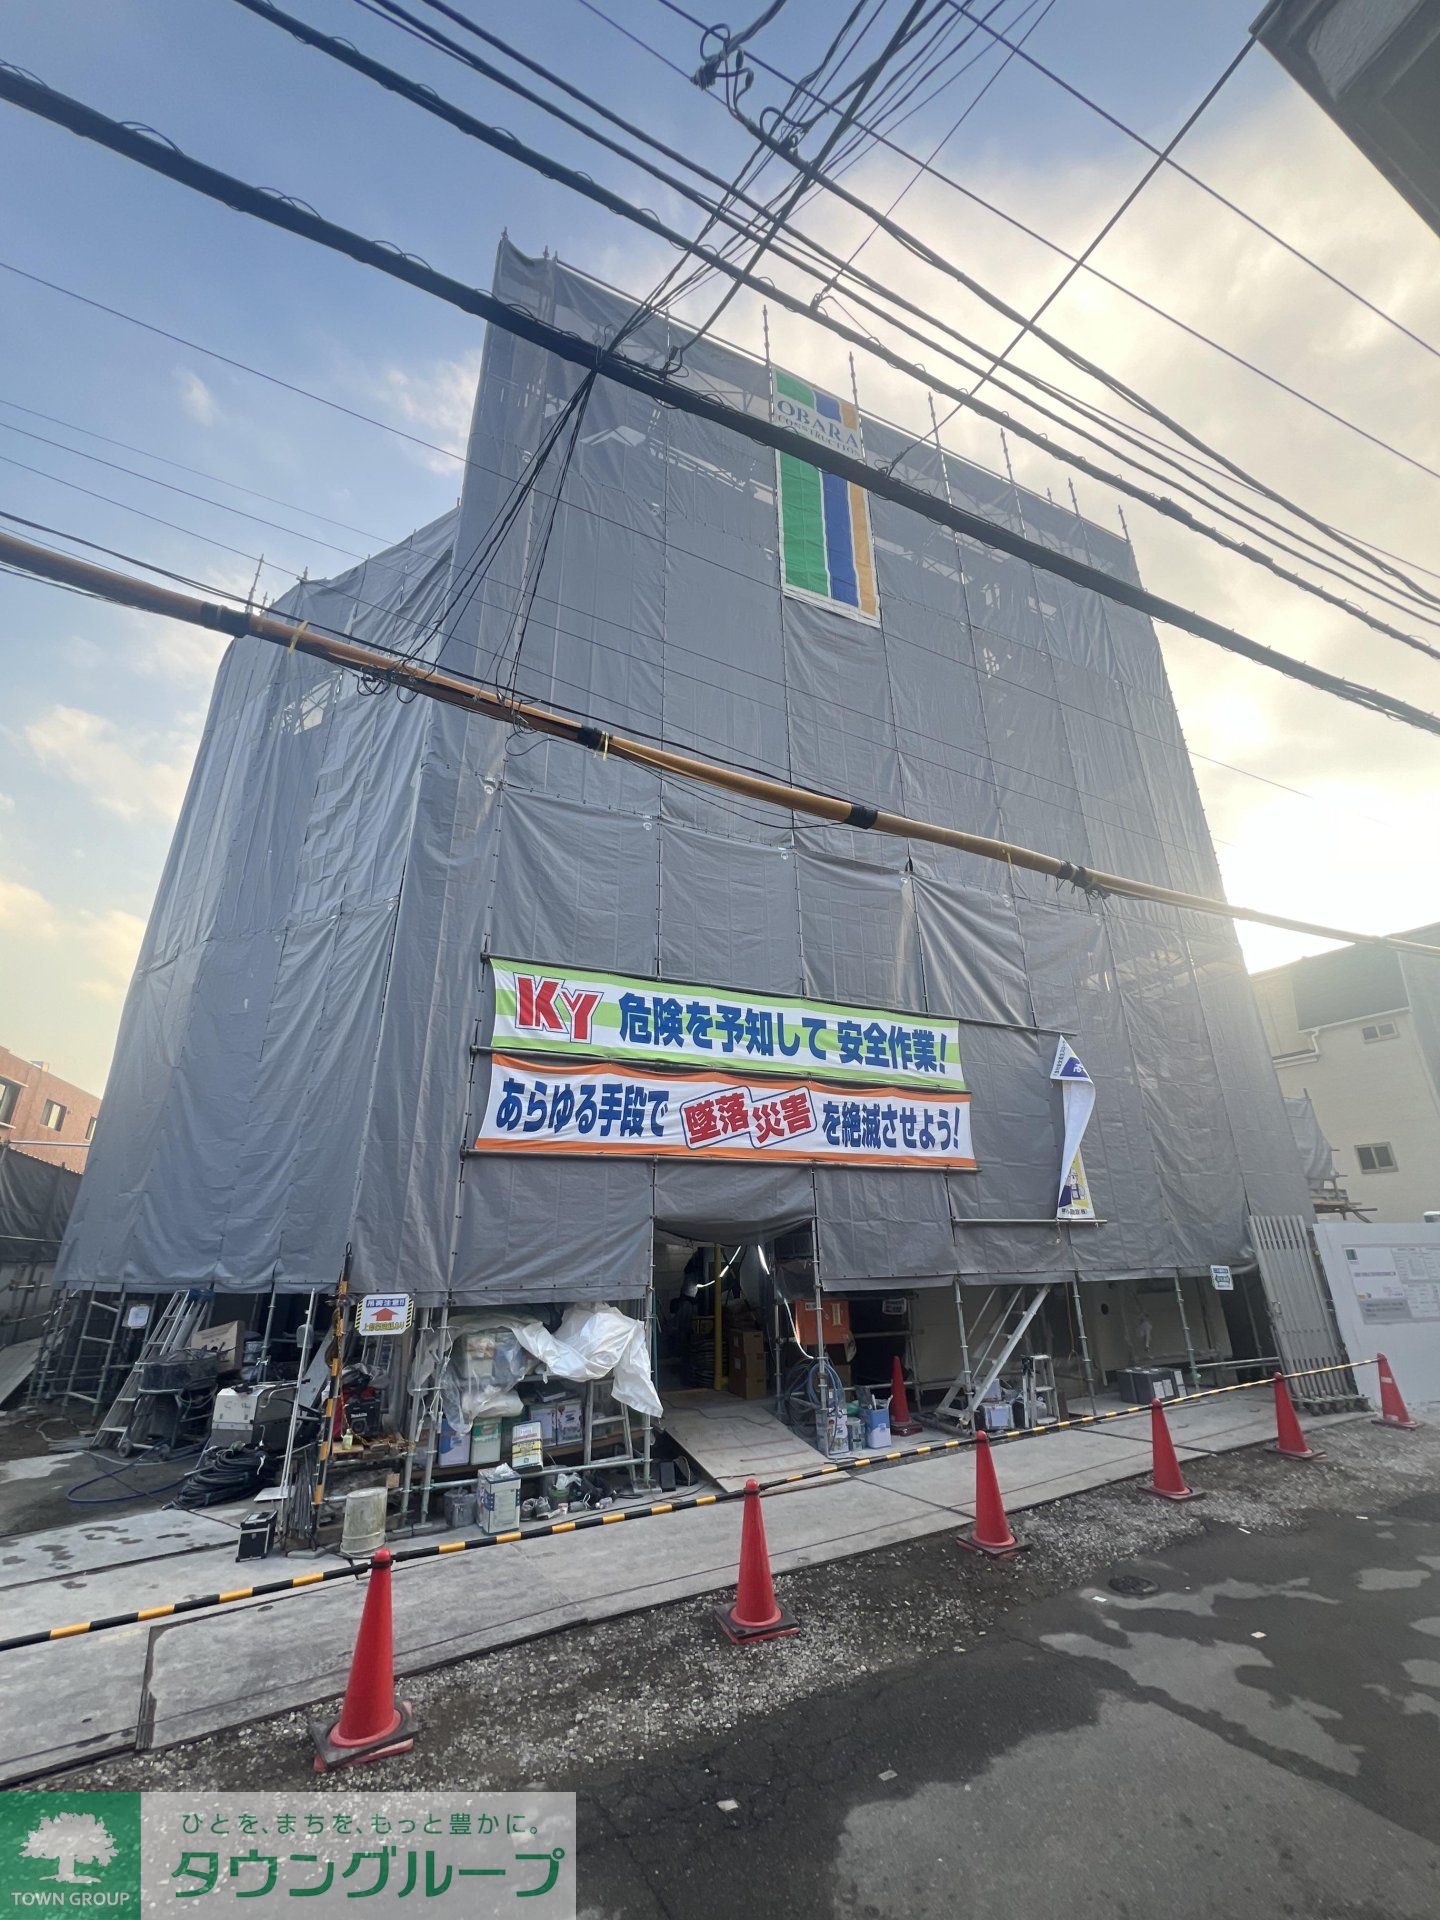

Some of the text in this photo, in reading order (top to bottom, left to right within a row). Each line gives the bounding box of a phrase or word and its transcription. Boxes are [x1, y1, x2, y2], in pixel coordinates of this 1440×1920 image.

[777, 400, 859, 448] OBARA
[514, 973, 601, 1042] KY
[495, 1077, 669, 1137] あらゆる手段で
[684, 1092, 812, 1144] 墜落災害
